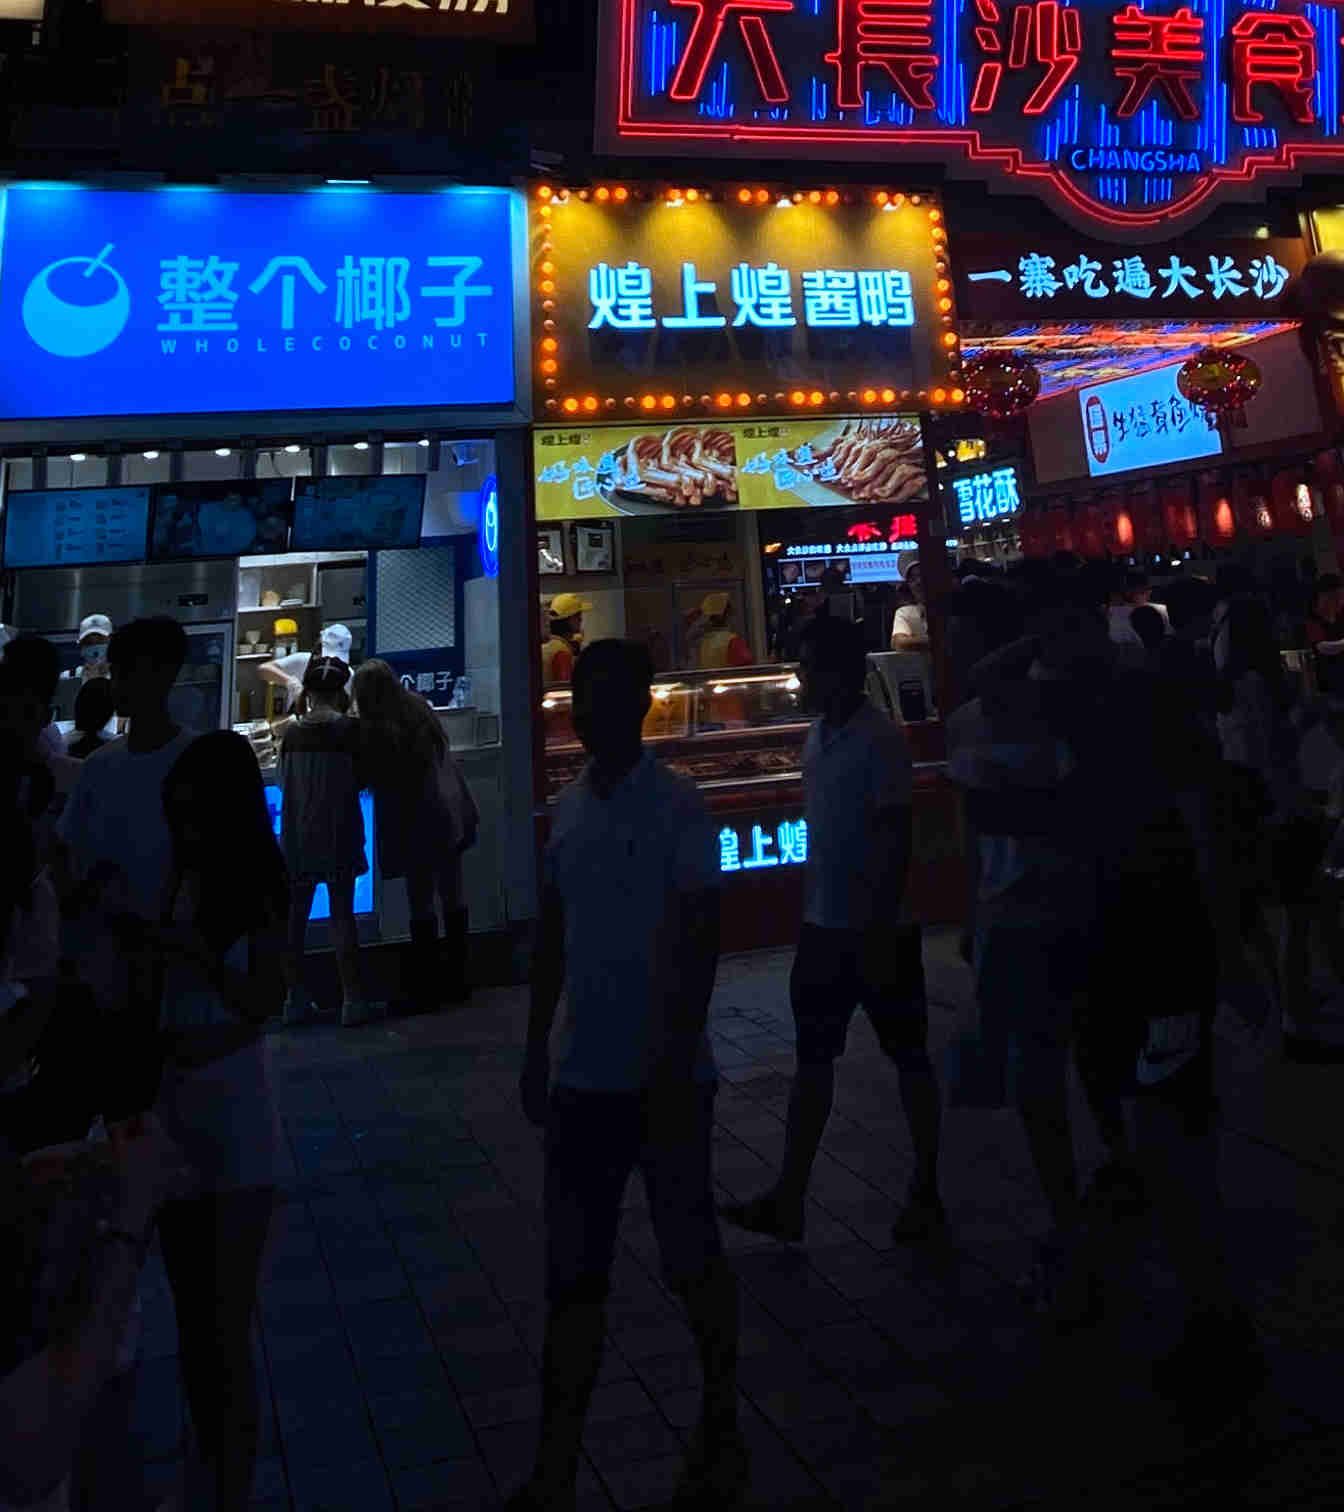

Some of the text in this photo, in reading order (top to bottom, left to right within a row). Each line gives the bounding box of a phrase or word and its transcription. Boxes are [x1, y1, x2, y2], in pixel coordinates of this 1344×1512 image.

[1067, 144, 1203, 174] CHANGSHA
[157, 255, 493, 331] 整个椰子
[587, 261, 916, 330] 煌上煌酱鸭
[967, 251, 1290, 300] 一寨吃遍大长沙
[952, 466, 1021, 525] 雪花酥
